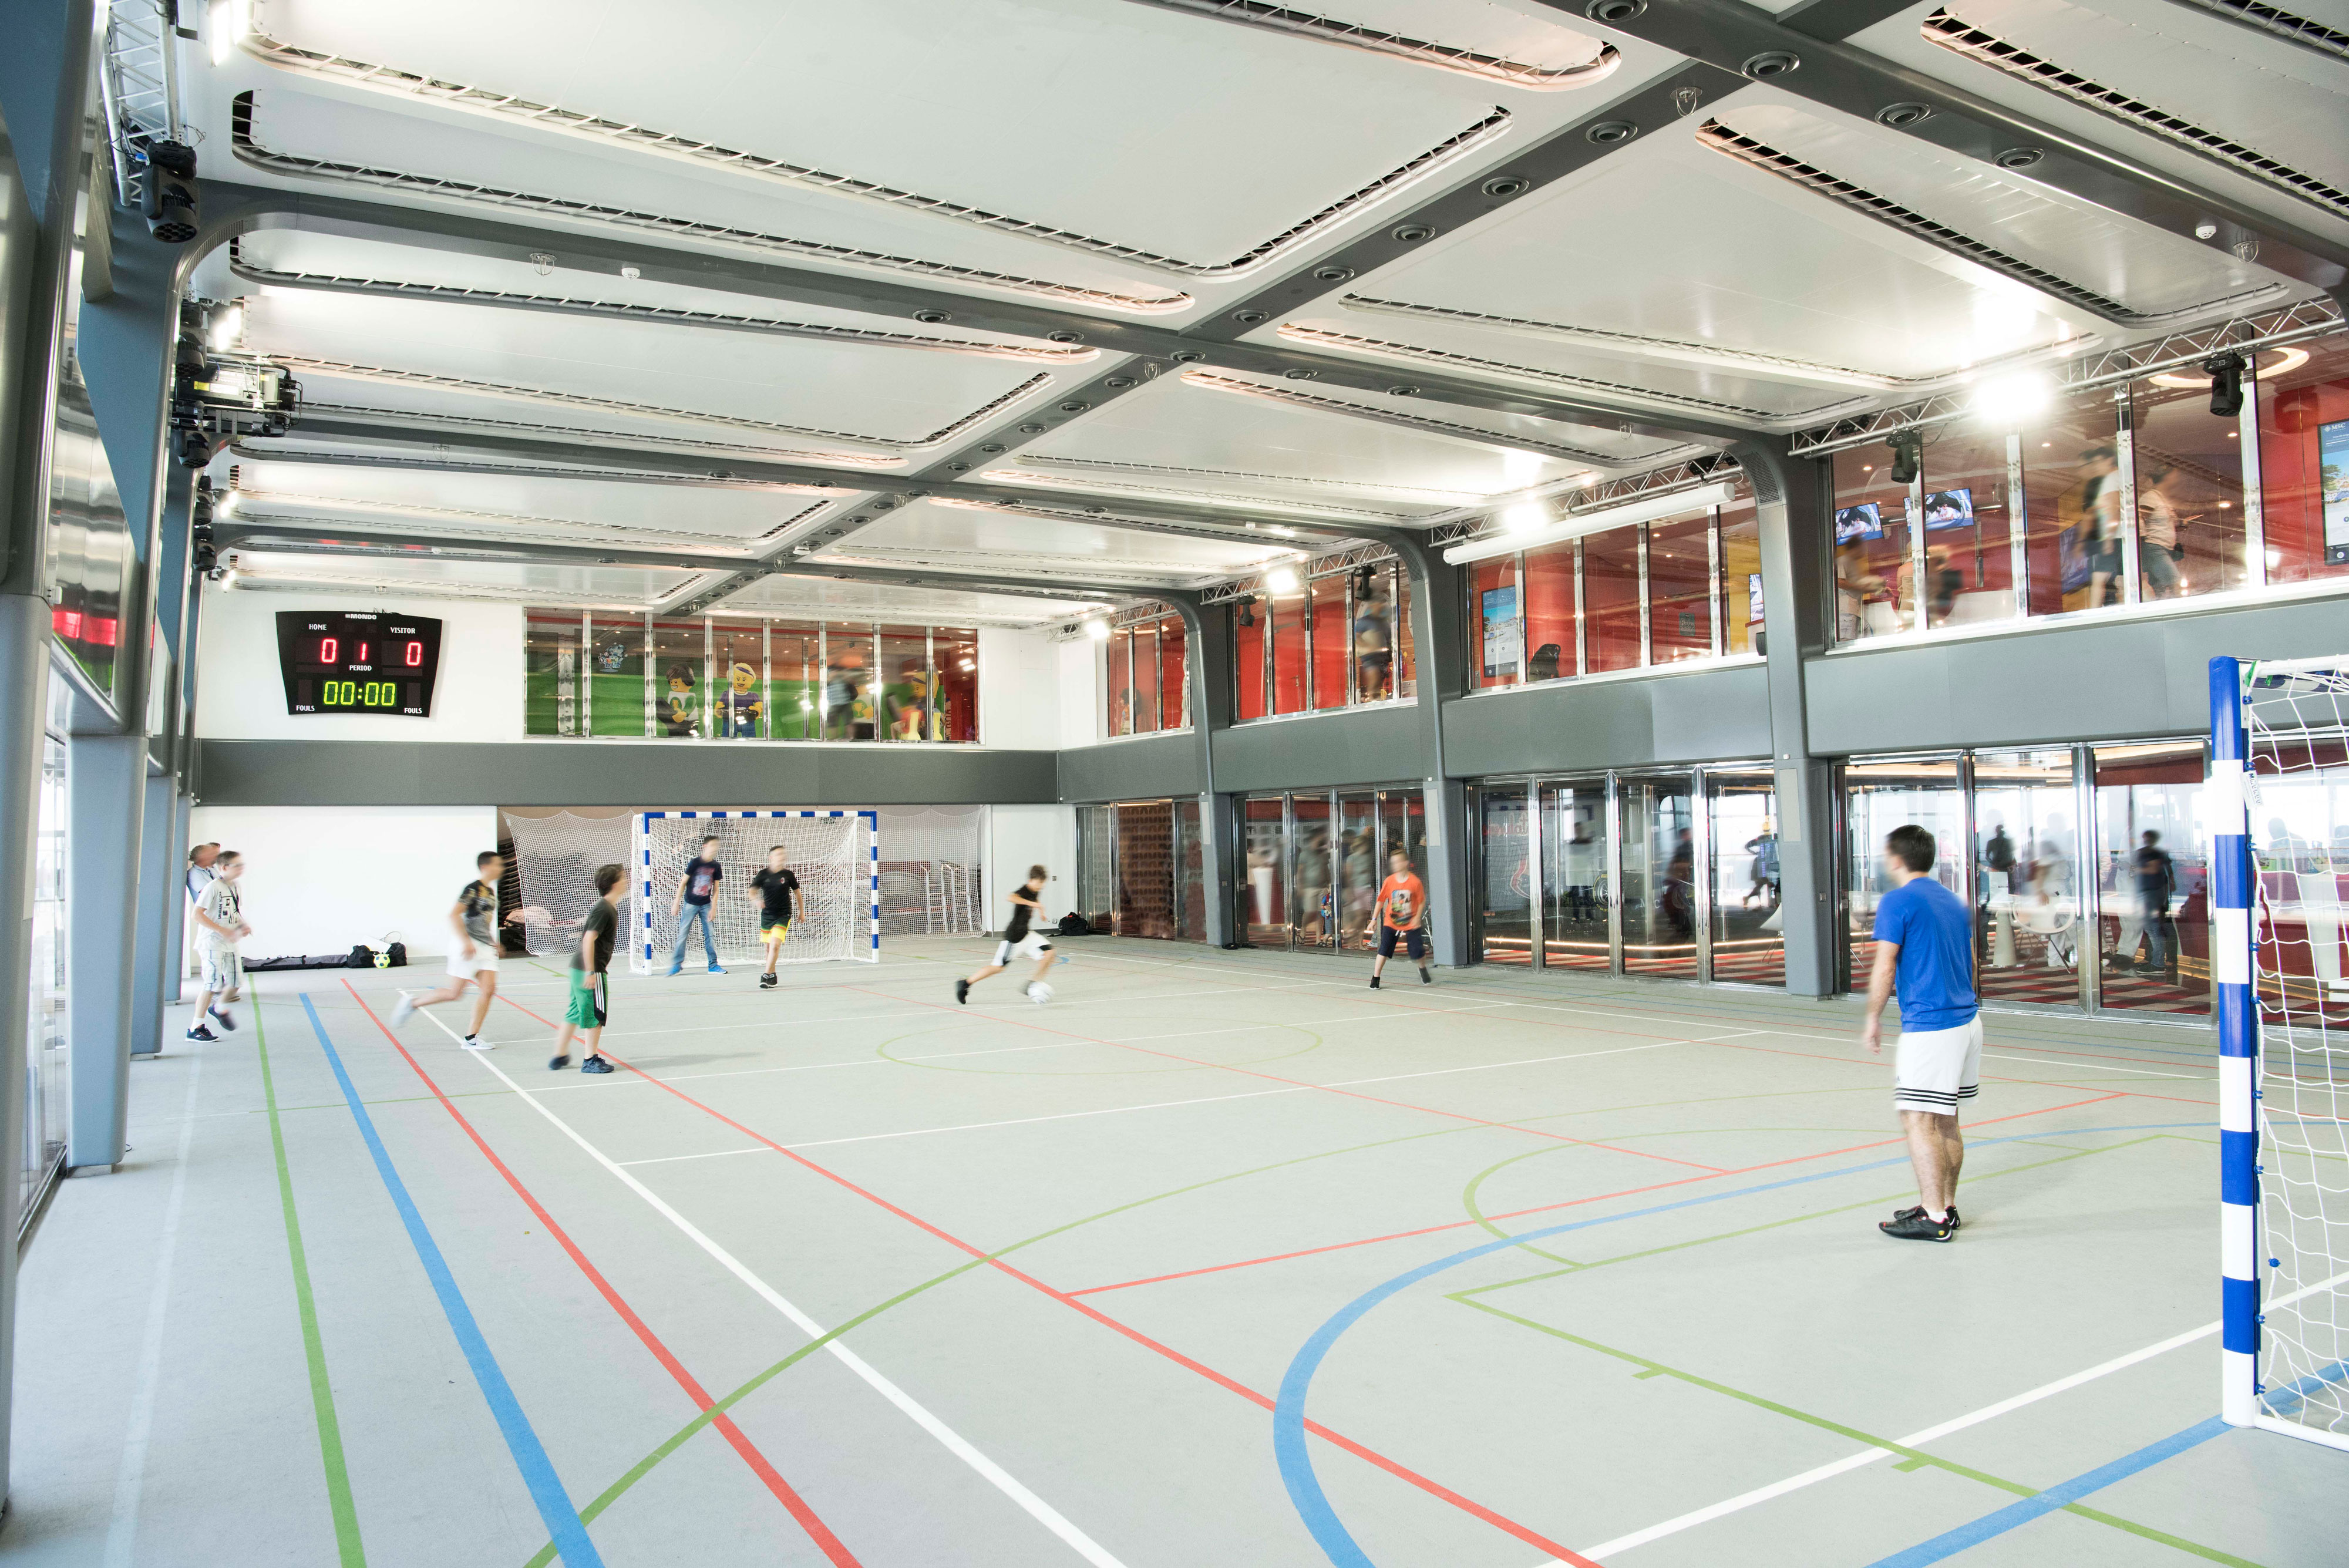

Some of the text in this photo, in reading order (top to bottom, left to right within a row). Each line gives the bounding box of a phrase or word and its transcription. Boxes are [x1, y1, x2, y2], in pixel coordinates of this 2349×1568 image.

[322, 639, 336, 662] 0
[361, 644, 366, 661] 1
[407, 642, 421, 665] 0
[324, 682, 395, 705] 00:00
